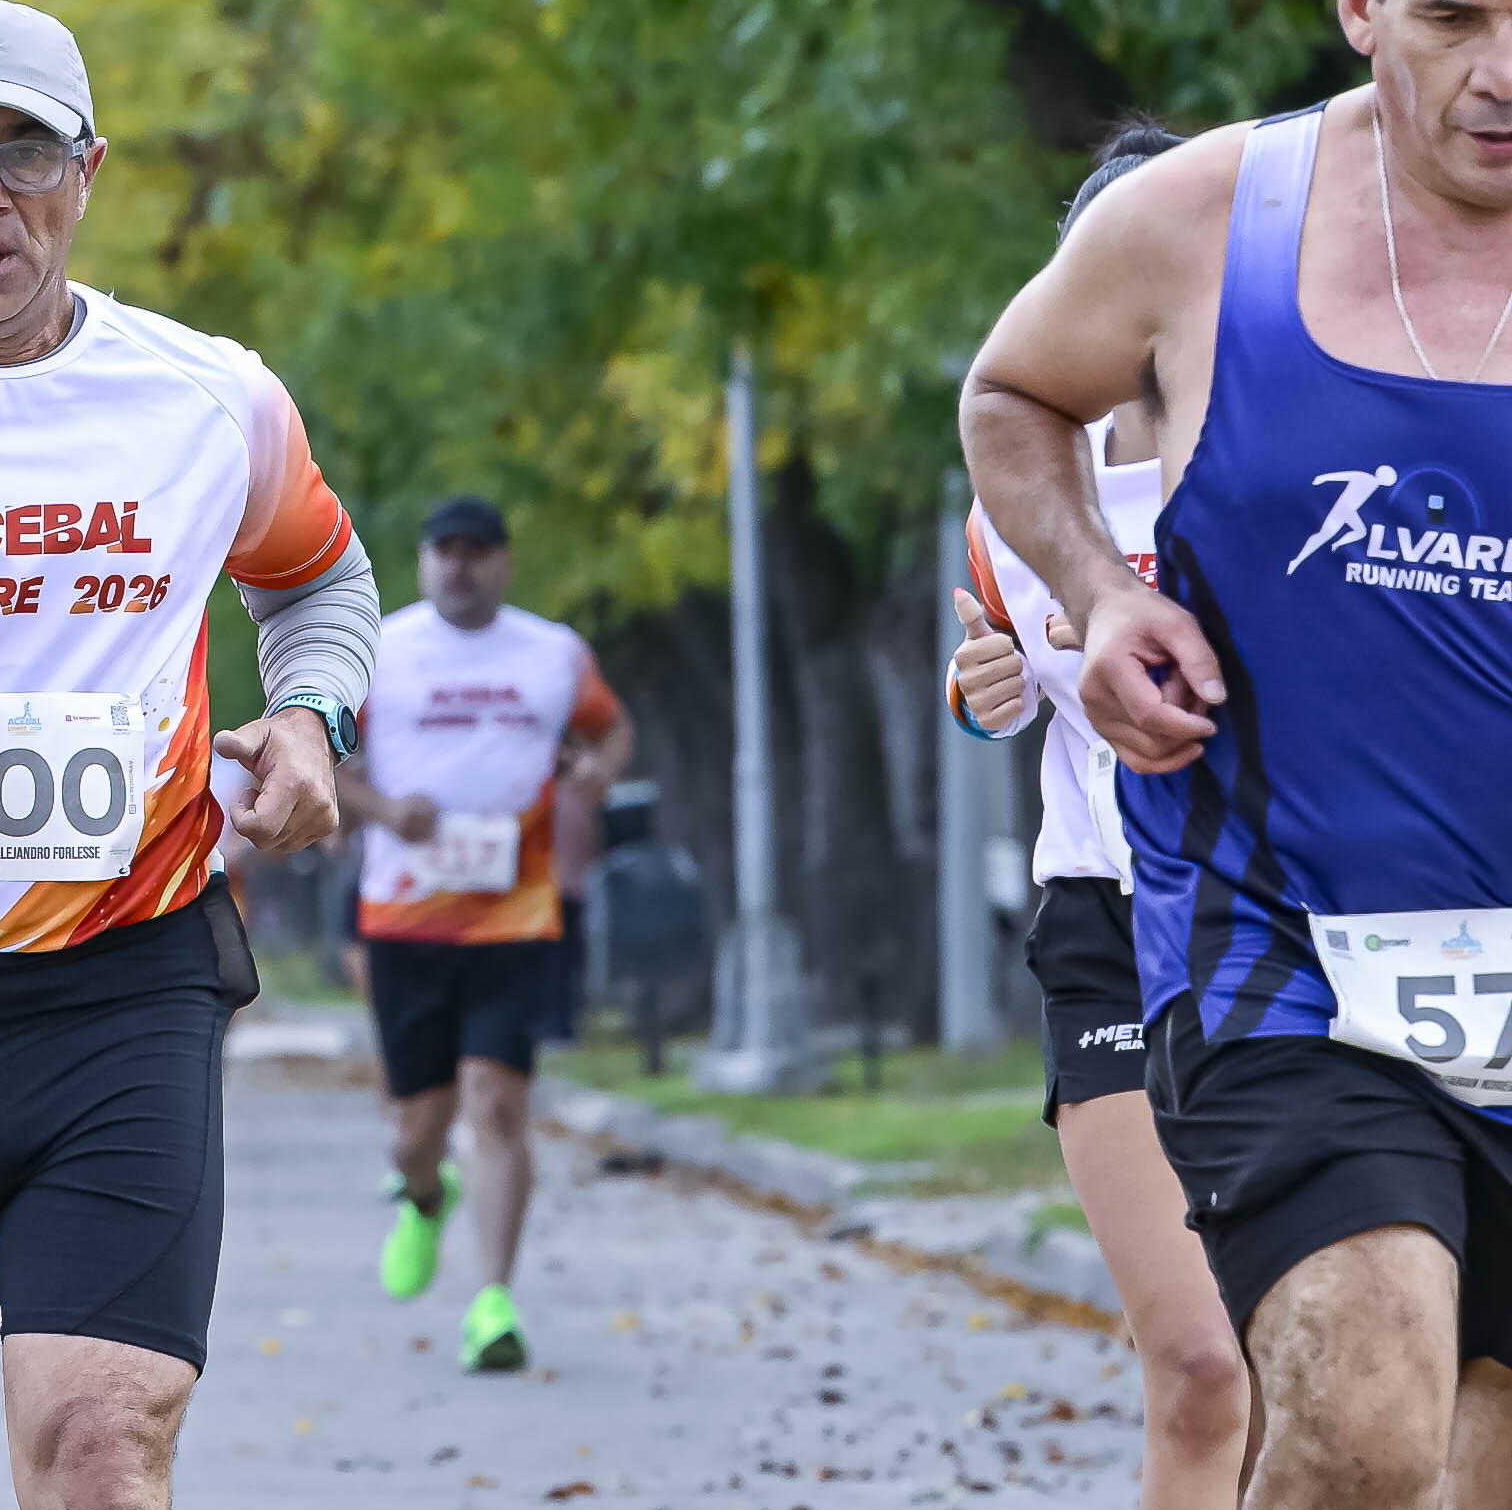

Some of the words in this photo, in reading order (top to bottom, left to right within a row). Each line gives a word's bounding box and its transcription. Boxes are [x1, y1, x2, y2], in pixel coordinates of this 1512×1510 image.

[69, 574, 171, 614] 2026
[1345, 562, 1461, 596] RUNNING
[52, 846, 101, 860] FORLESSE
[1397, 972, 1512, 1070] 57
